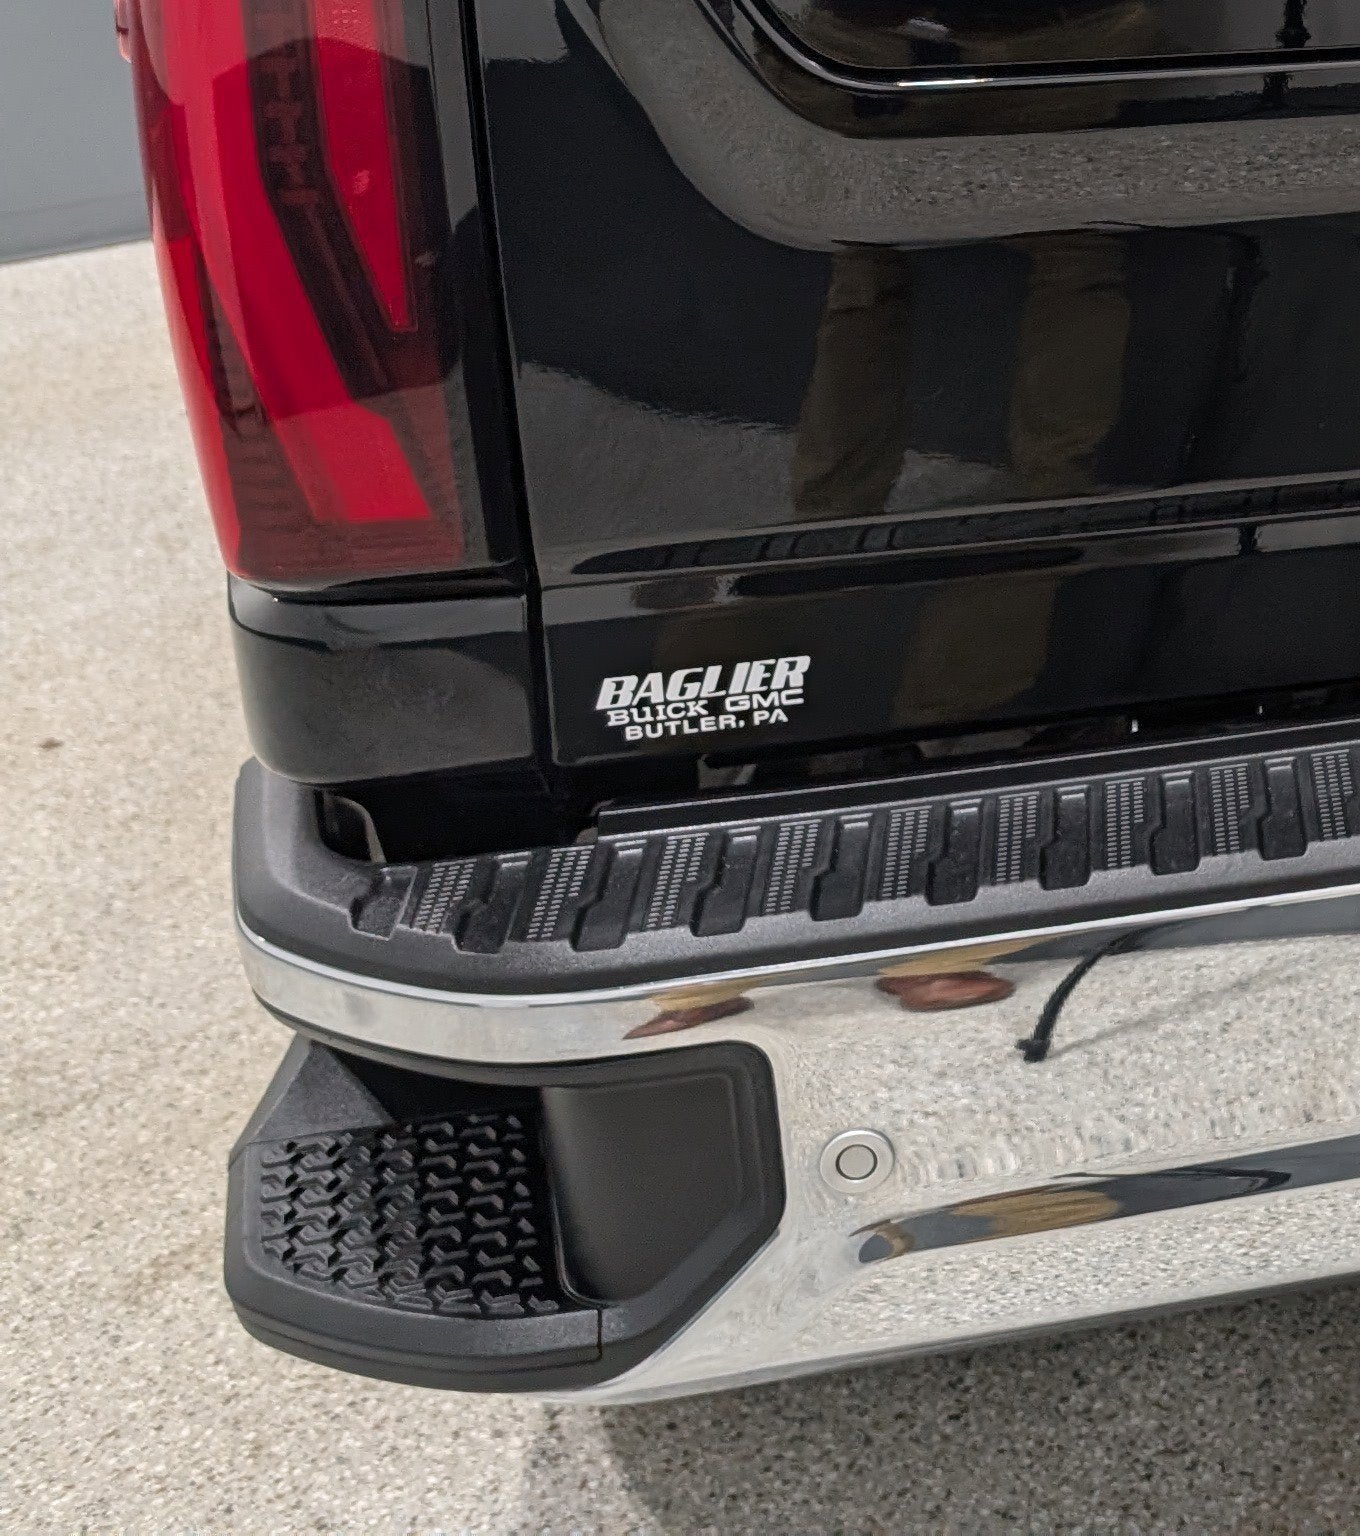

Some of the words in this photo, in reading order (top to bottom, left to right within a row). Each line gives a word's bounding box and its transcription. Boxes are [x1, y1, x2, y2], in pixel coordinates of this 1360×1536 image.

[595, 655, 811, 711] BAGLIER
[606, 700, 709, 727] BUICK
[725, 689, 805, 713] GMC
[753, 709, 789, 726] PA
